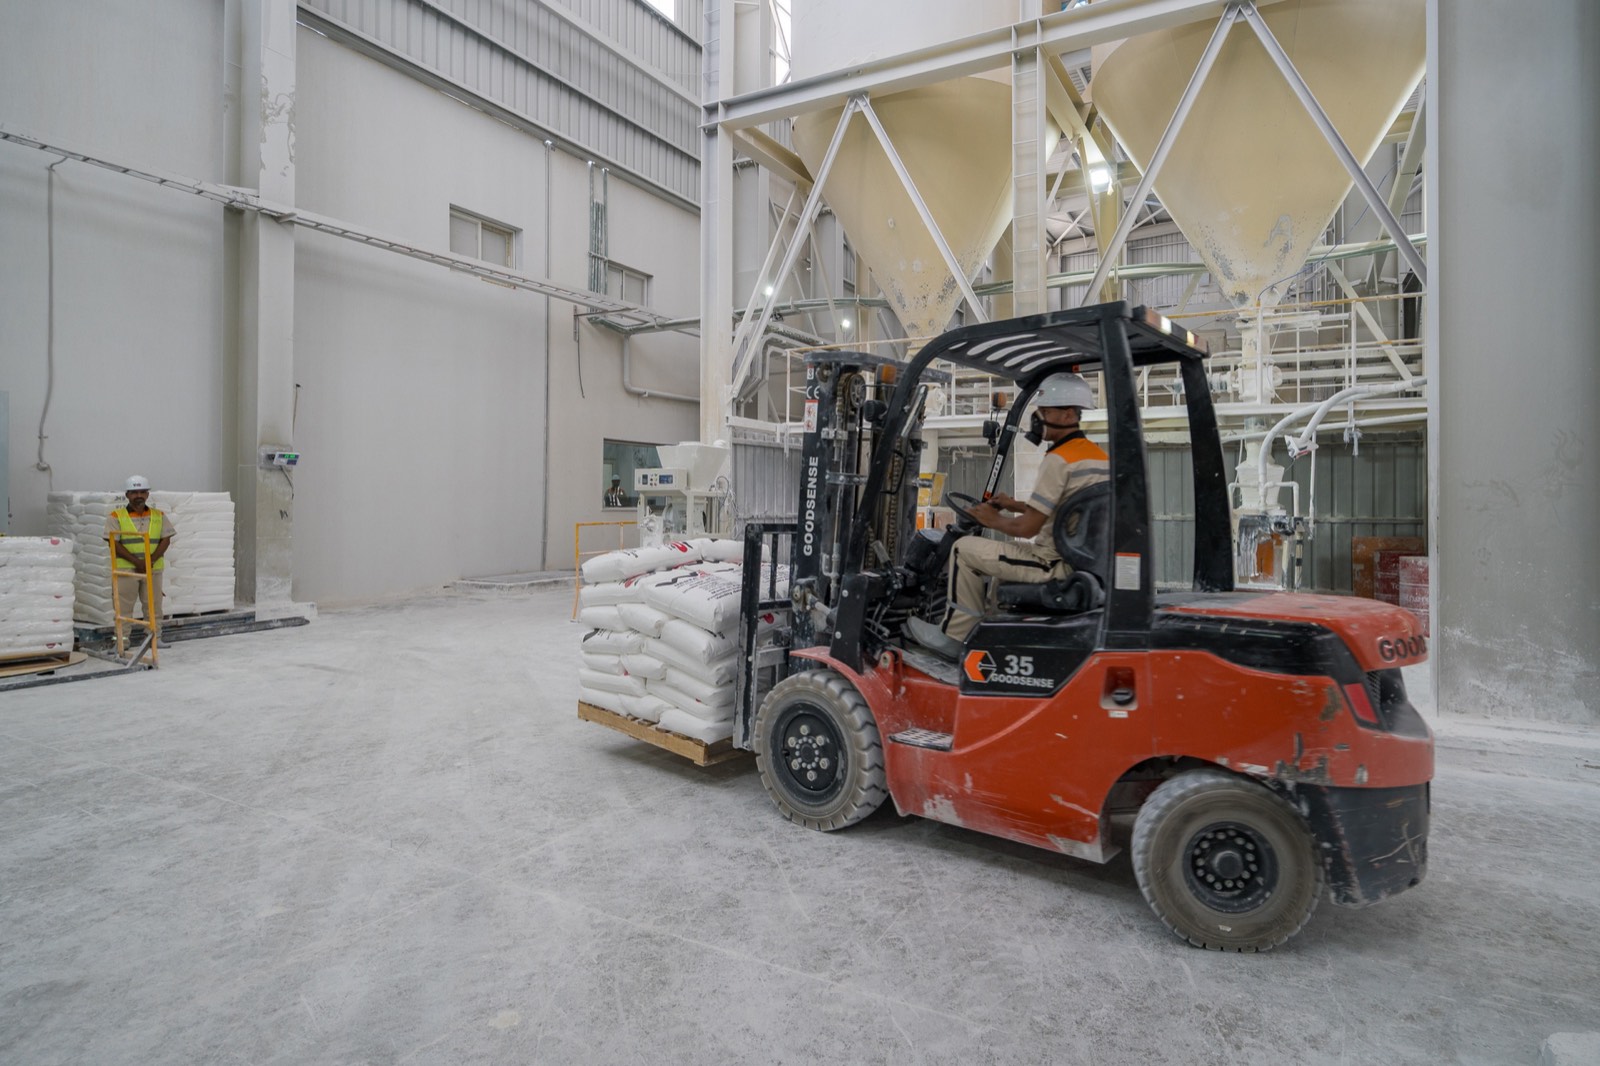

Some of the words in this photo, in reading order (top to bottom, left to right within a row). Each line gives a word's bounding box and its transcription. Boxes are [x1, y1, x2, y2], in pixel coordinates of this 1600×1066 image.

[803, 456, 818, 556] GOODSENSE
[1004, 655, 1034, 675] 35
[991, 673, 1054, 688] GOODSENSE
